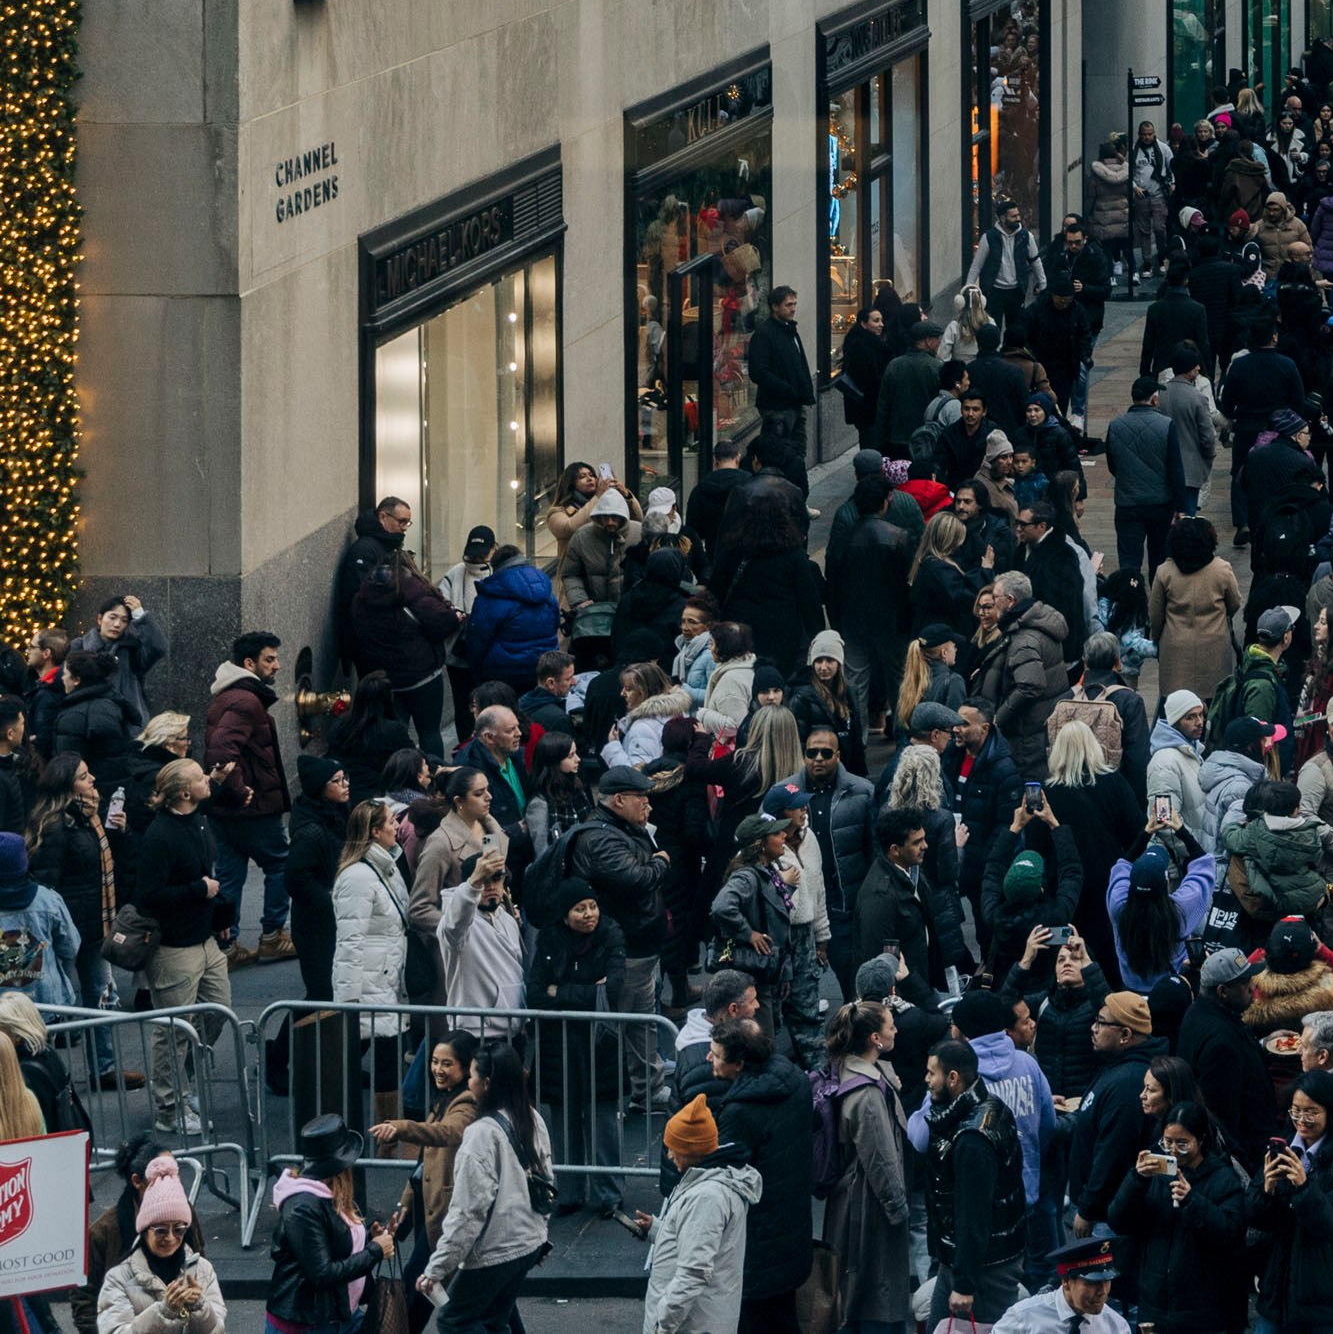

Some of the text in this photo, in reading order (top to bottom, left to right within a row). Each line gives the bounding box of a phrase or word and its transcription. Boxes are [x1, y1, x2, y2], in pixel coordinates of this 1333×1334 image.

[1134, 78, 1145, 86] THE
[275, 141, 338, 188] CHANNEL
[276, 174, 338, 223] GARDENS
[386, 207, 500, 299] MICHAEL KORS
[32, 1249, 75, 1265] GOOD
